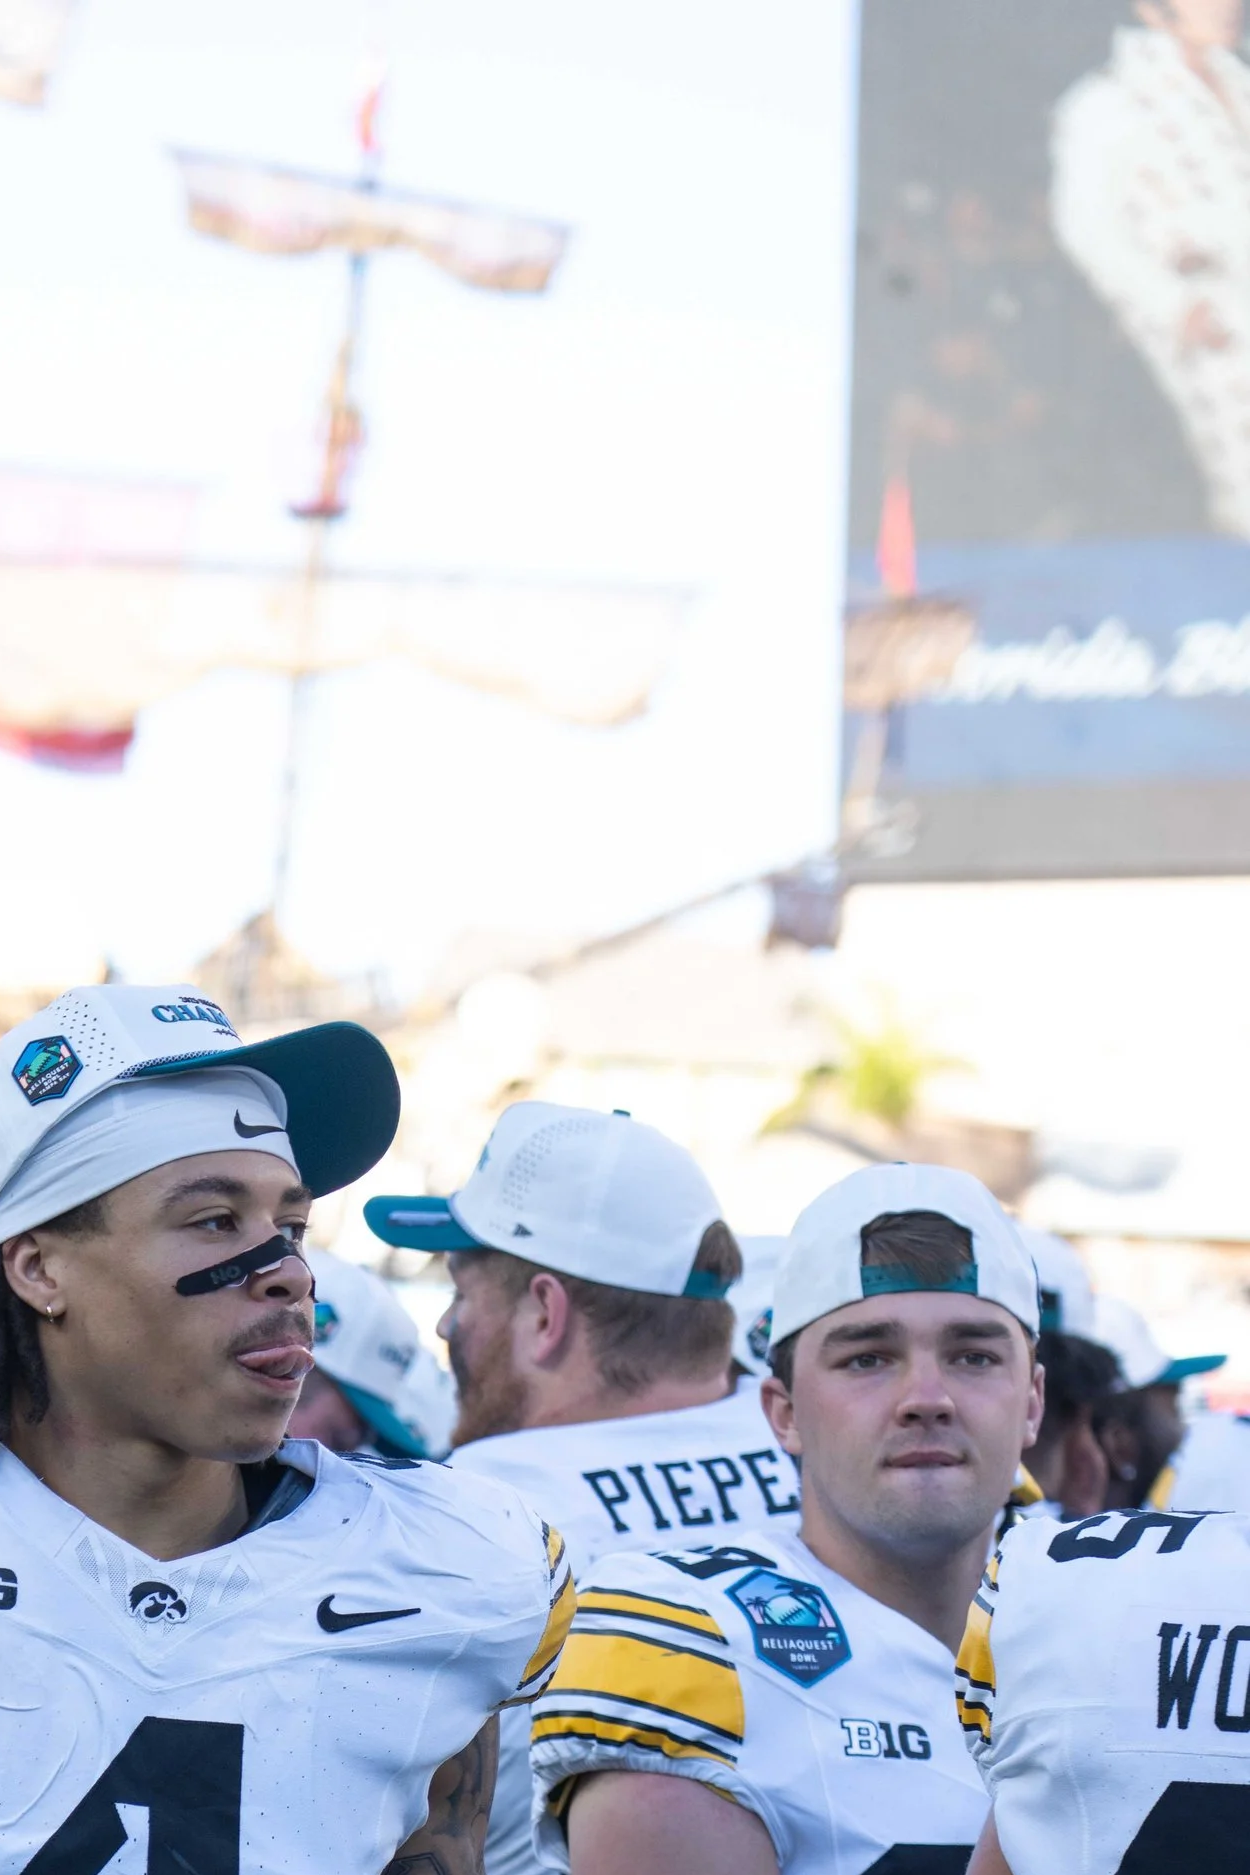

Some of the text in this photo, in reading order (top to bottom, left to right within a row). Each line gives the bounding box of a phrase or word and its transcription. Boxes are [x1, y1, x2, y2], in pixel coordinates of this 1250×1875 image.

[28, 1062, 70, 1096] RELIAQUEST
[43, 1074, 61, 1088] BOWL
[38, 1080, 59, 1095] TAMPA
[582, 1448, 801, 1533] PIEPE
[762, 1637, 834, 1652] RELIAQUEST
[789, 1652, 818, 1663] BOWL
[1157, 1622, 1250, 1733] WO
